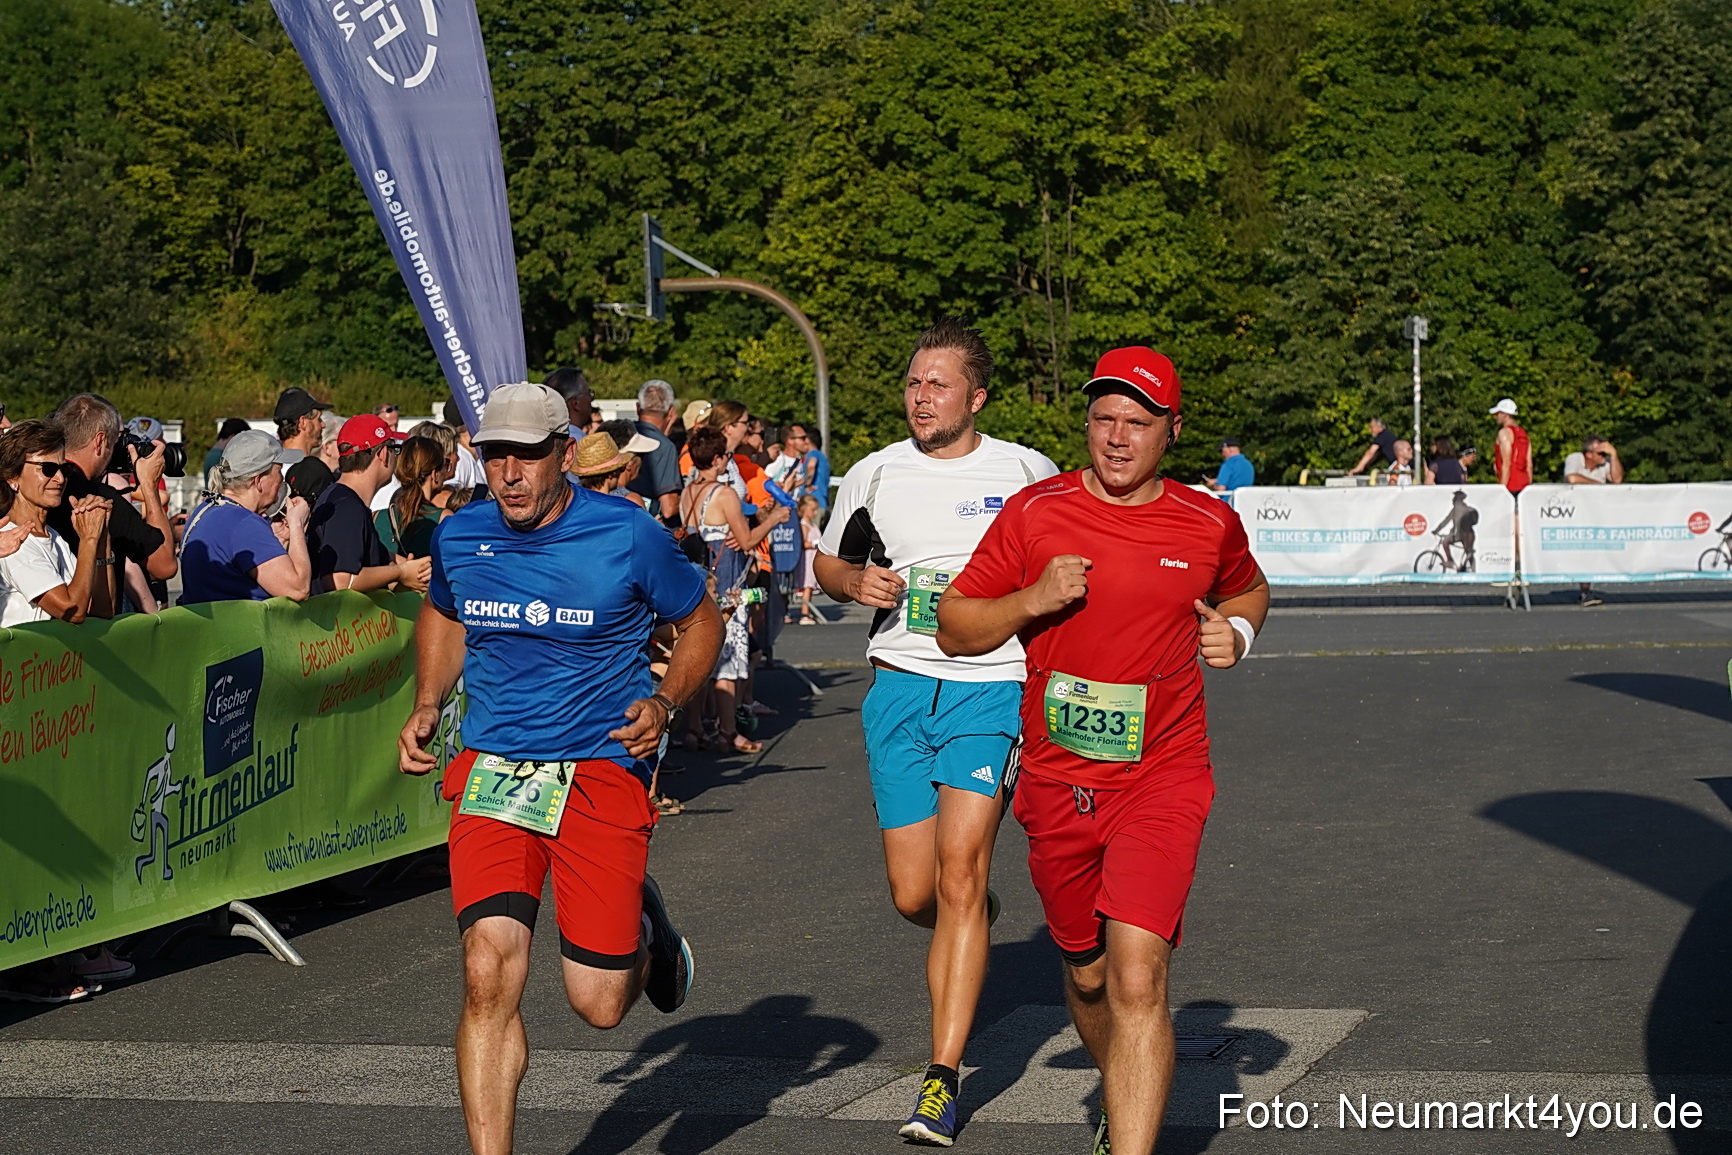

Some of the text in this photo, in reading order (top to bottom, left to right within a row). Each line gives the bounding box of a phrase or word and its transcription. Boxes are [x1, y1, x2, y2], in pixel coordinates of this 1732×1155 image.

[1257, 508, 1291, 520] NOW
[1540, 506, 1575, 519] NOW
[1258, 528, 1406, 543] E-BIKES & FAHRRÄDER
[1543, 527, 1690, 541] E-BIKES & FAHRRÄDER
[1160, 558, 1189, 570] Florian
[464, 599, 521, 618] SCHICK
[559, 611, 590, 623] BAU
[911, 597, 920, 619] RUN
[352, 609, 399, 651] Firmen
[481, 620, 500, 628] schick
[500, 622, 520, 630] bauen
[21, 651, 83, 699] Firmen
[216, 688, 253, 717] Fischer
[1068, 690, 1099, 702] Firmenlauf
[31, 684, 96, 759] länger!
[1048, 706, 1058, 732] RUN
[1060, 702, 1126, 736] 1233
[1057, 726, 1128, 747] Maierhofer Florian
[1126, 716, 1140, 751] 2022
[179, 722, 299, 841] firmenlauf
[468, 776, 483, 801] RUN
[491, 771, 543, 804] 726
[475, 794, 505, 807] Schick
[507, 800, 547, 818] Matthias
[545, 789, 563, 824] 2022
[180, 822, 237, 870] neumarkt
[264, 803, 408, 873] www.firmenlauf-oberpfalz.de
